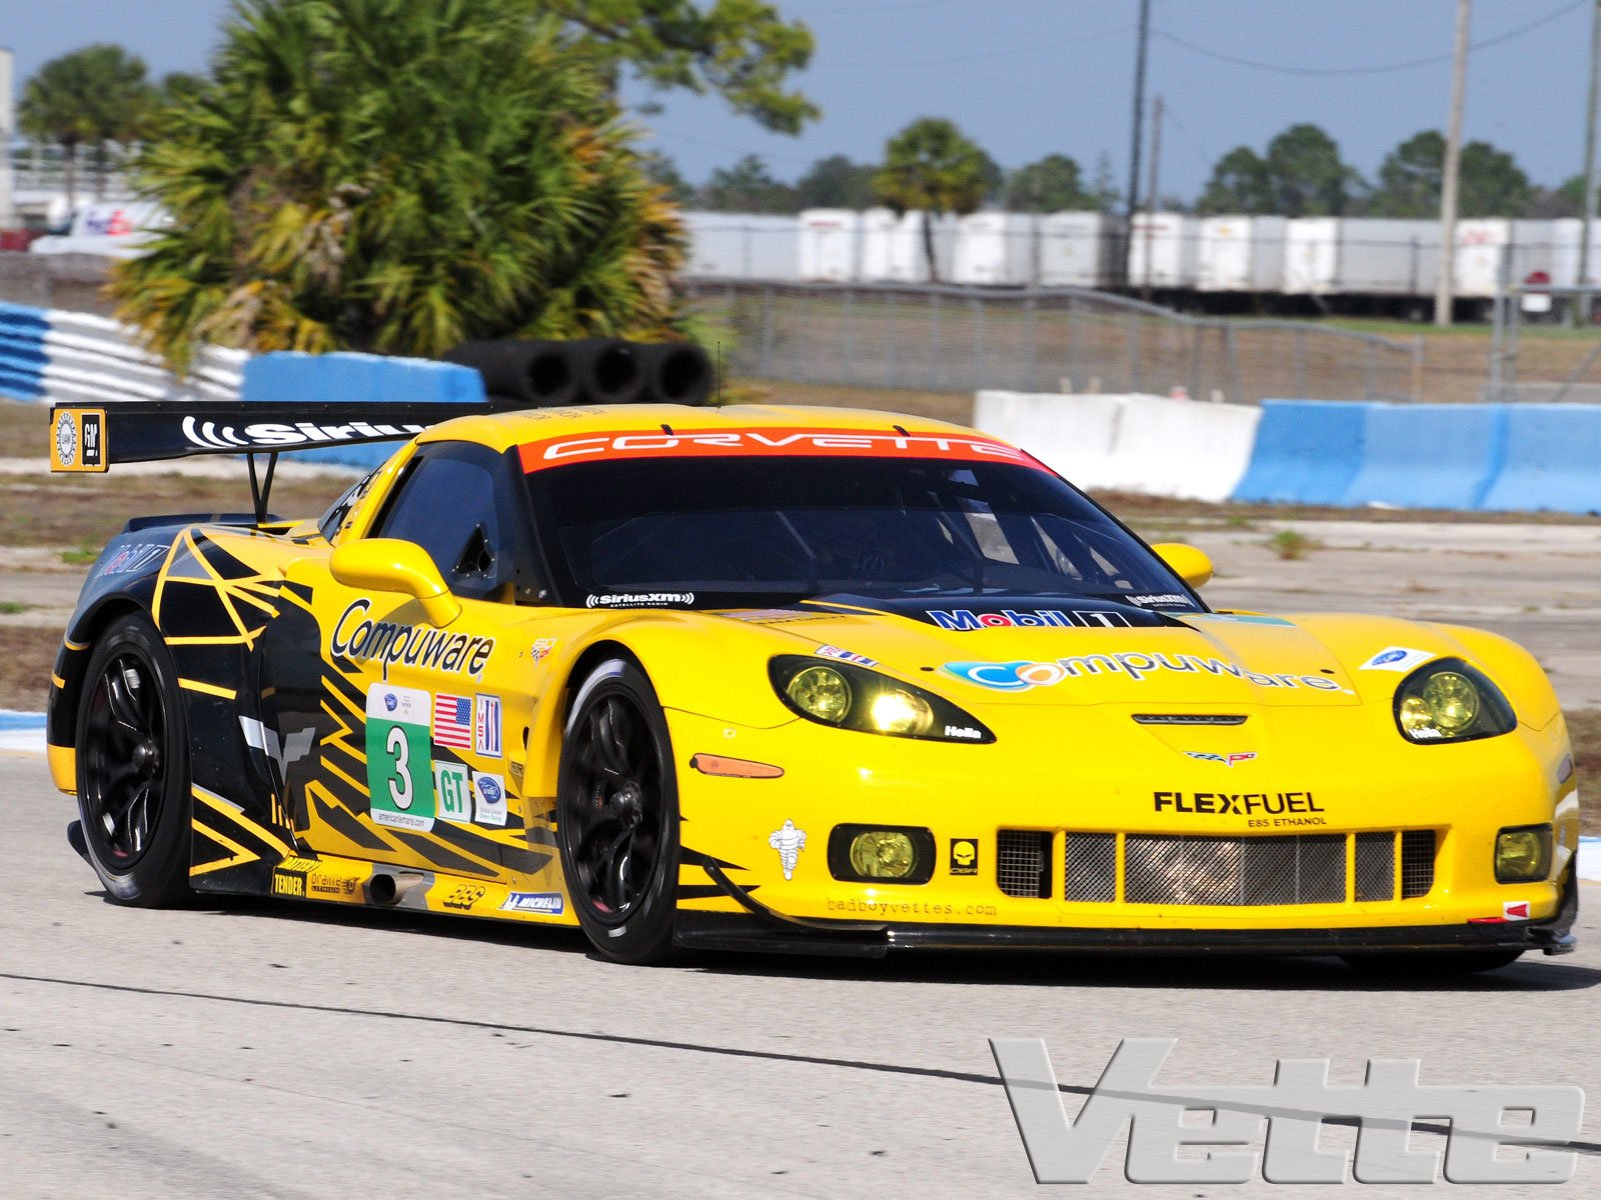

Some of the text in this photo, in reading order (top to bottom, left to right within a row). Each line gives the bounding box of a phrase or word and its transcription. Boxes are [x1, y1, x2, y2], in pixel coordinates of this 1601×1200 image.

[85, 423, 98, 448] GM
[543, 433, 1024, 460] CORVETTE
[928, 609, 1072, 631] Mobil
[331, 598, 495, 683] Compuware
[965, 650, 1339, 692] Compuware
[944, 725, 982, 739] Hella
[386, 725, 414, 811] 3
[440, 769, 464, 814] GT
[1154, 792, 1325, 815] FLEXFUEL
[1248, 816, 1327, 828] E85 ETHANOL
[275, 874, 303, 896] TENDER
[826, 897, 997, 916] badboyvettes.com
